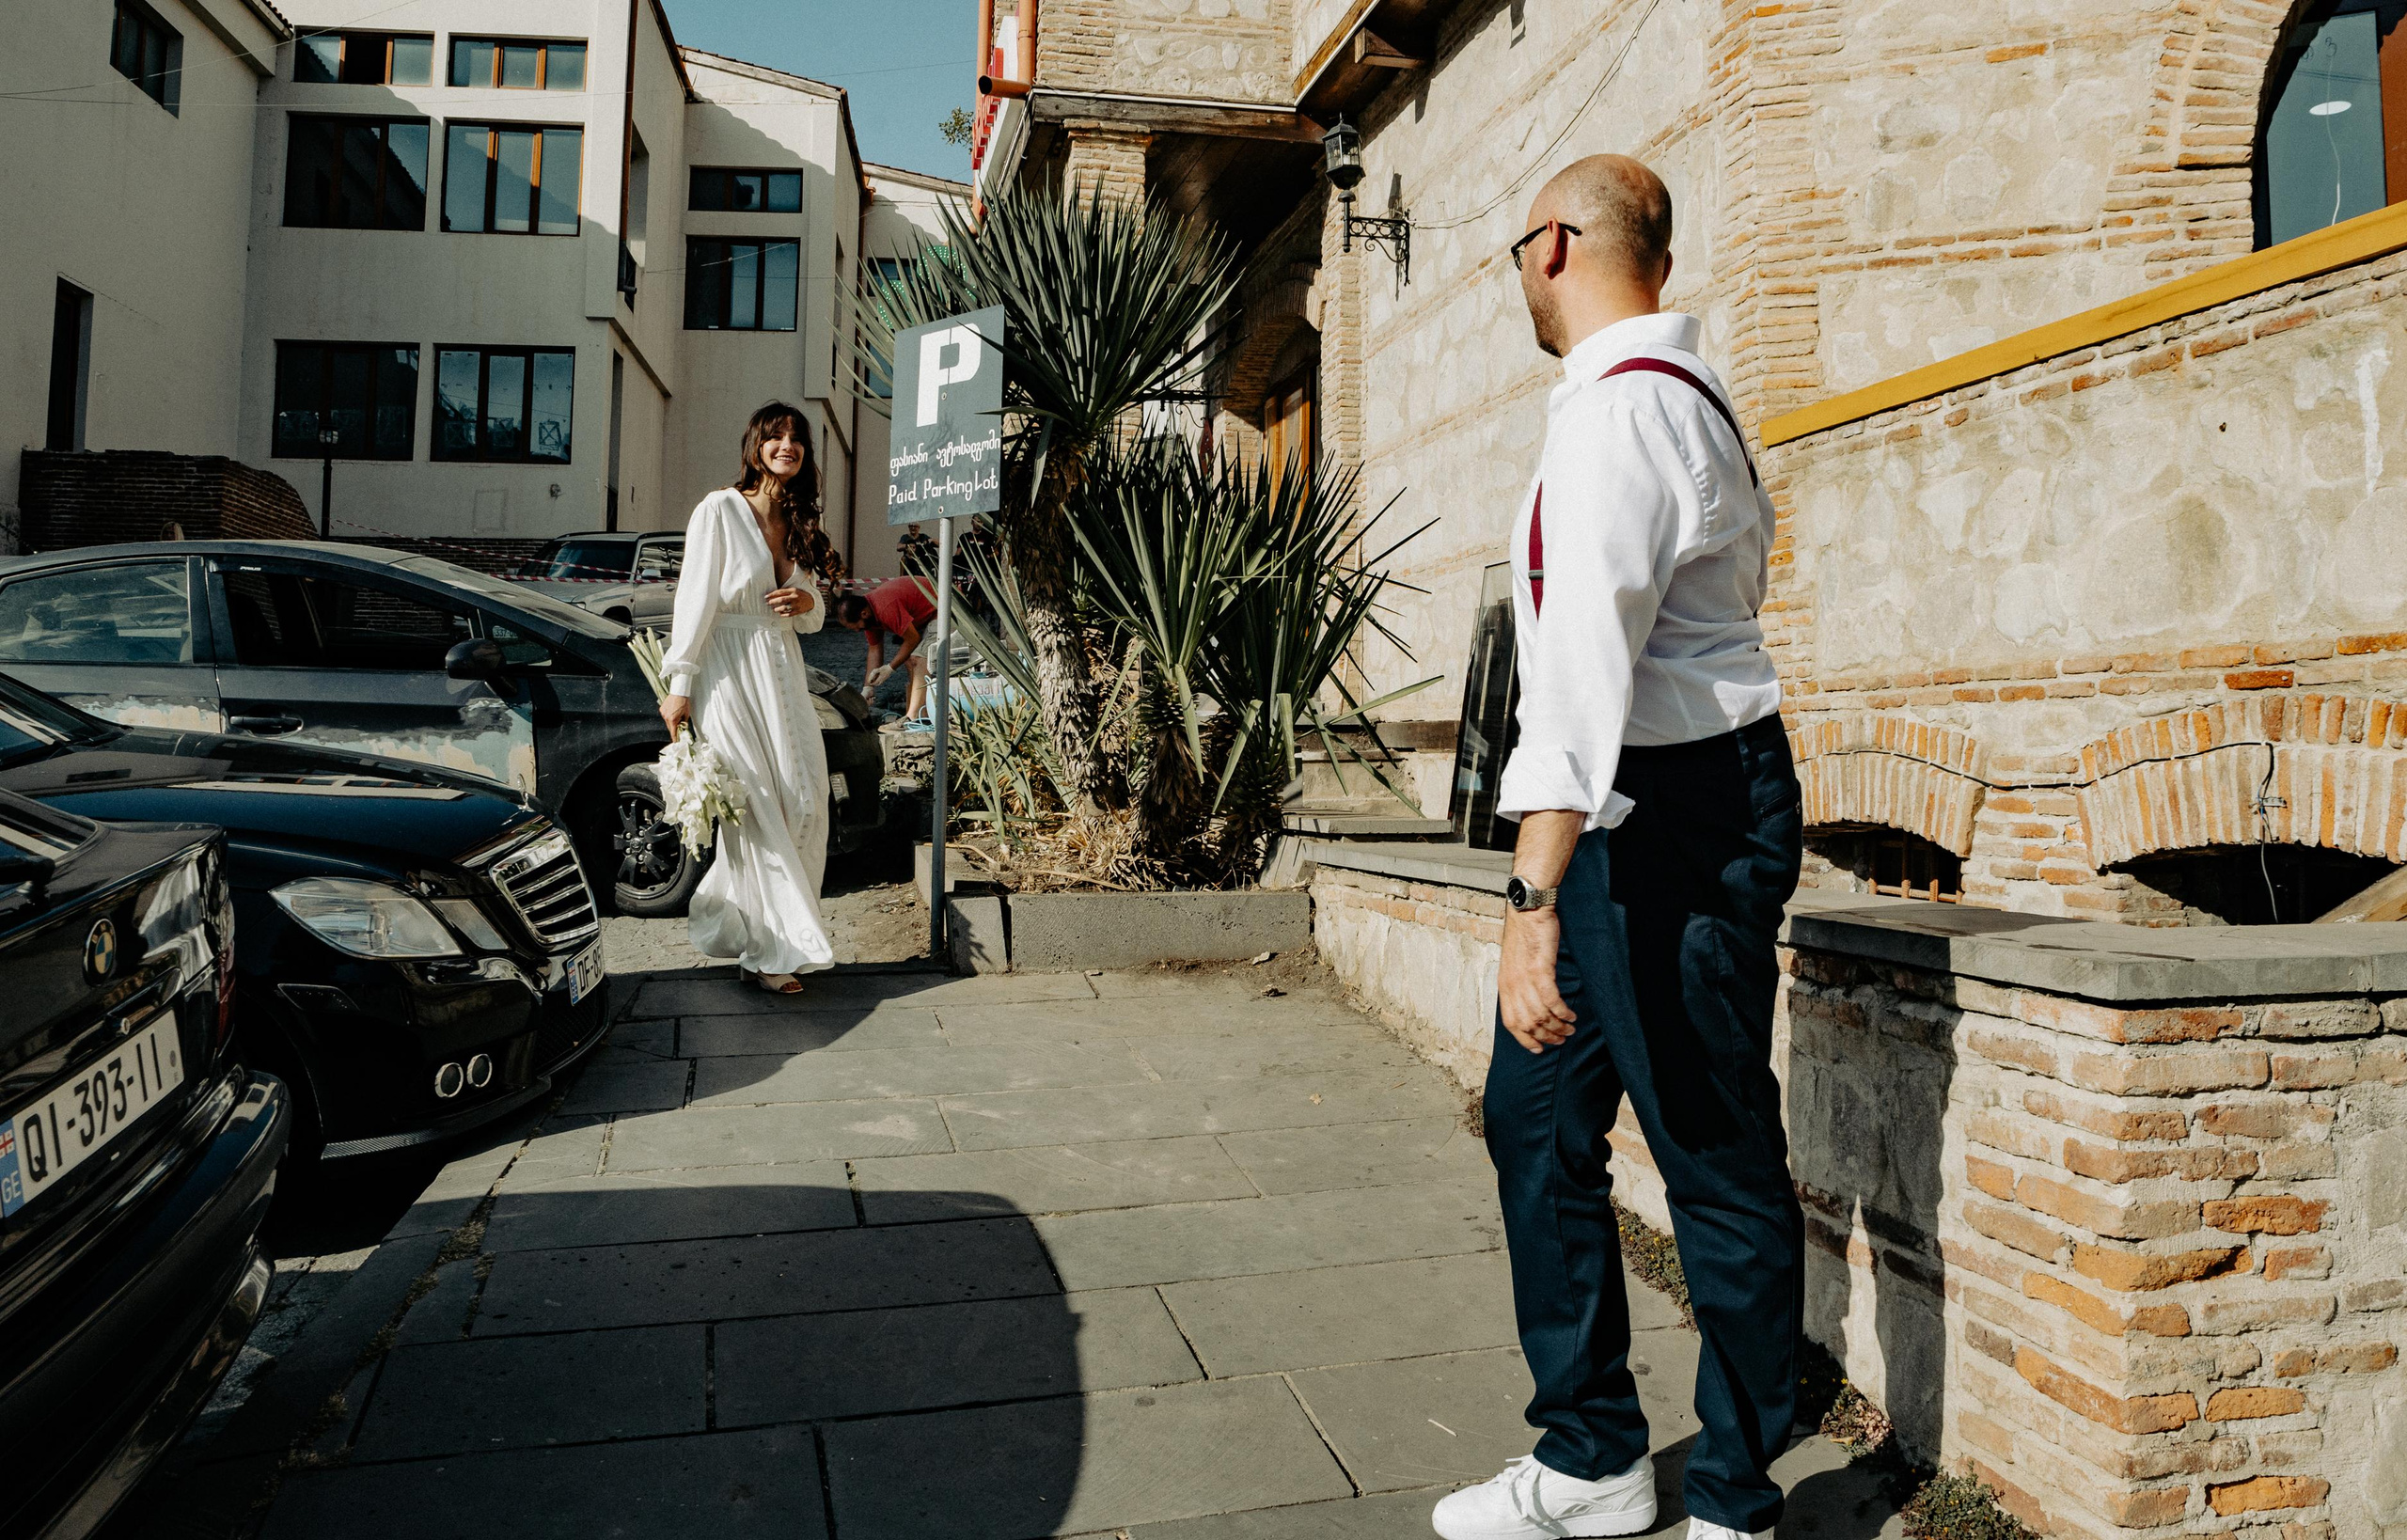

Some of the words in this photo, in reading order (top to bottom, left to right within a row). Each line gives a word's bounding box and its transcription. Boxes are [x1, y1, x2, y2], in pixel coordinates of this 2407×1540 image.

[917, 322, 982, 428] P
[889, 443, 928, 477] ფასიანი
[889, 480, 918, 505] Paid
[2, 1170, 21, 1203] GE
